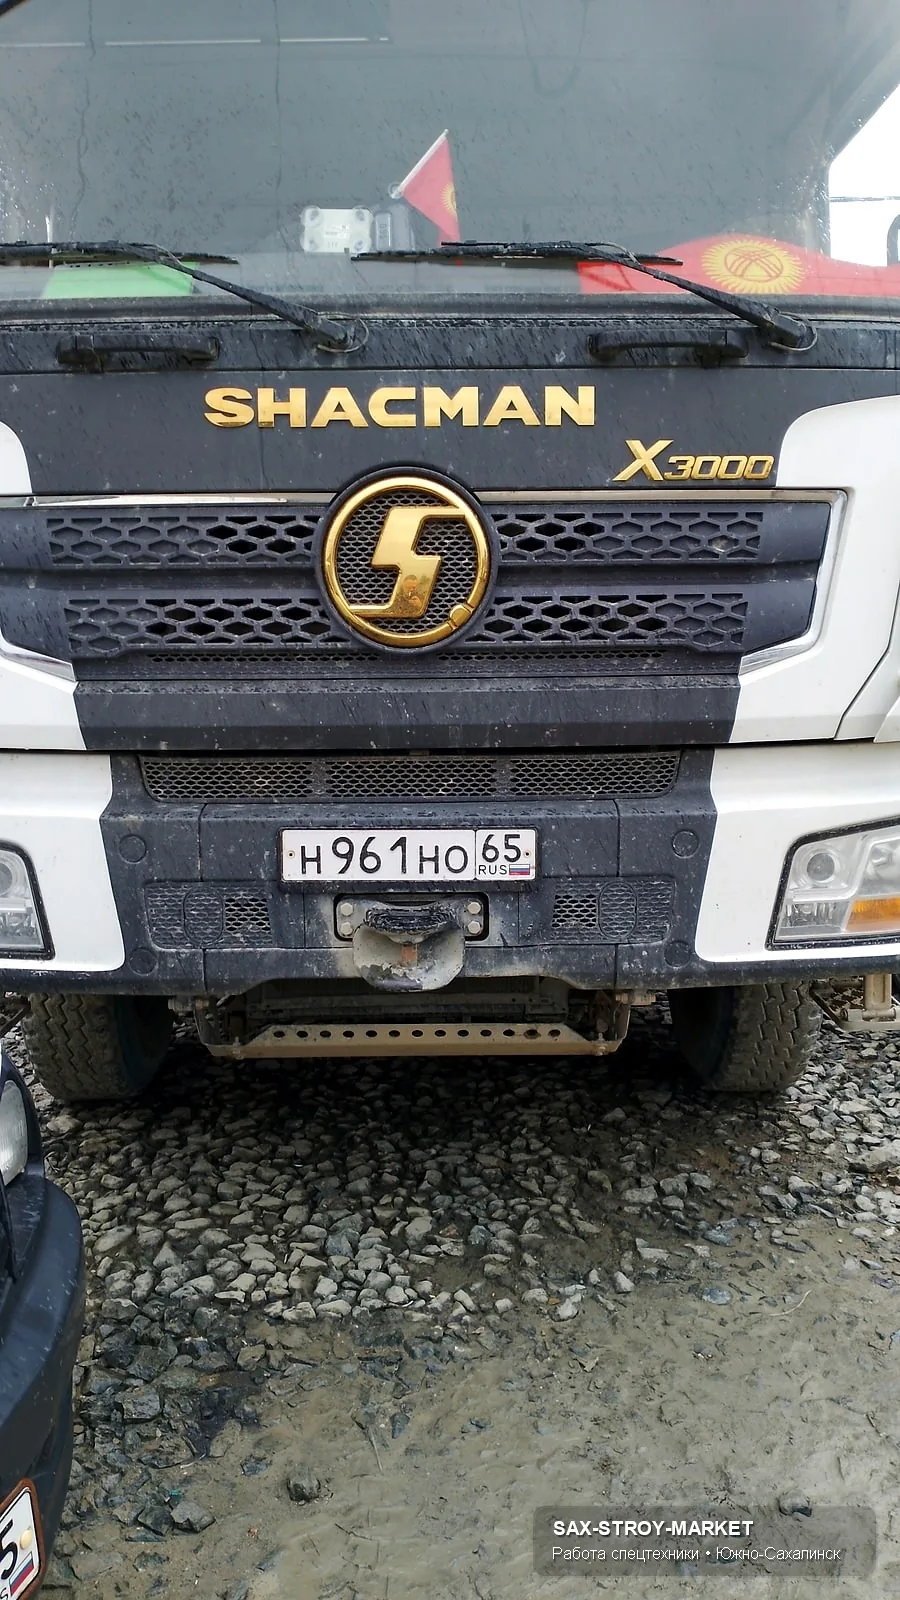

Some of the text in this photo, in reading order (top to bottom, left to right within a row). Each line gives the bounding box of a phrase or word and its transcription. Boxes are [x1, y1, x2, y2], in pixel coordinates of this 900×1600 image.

[204, 385, 596, 429] SHACMAN
[612, 438, 776, 483] X3000
[481, 833, 522, 863] 65
[478, 864, 508, 876] RUS
